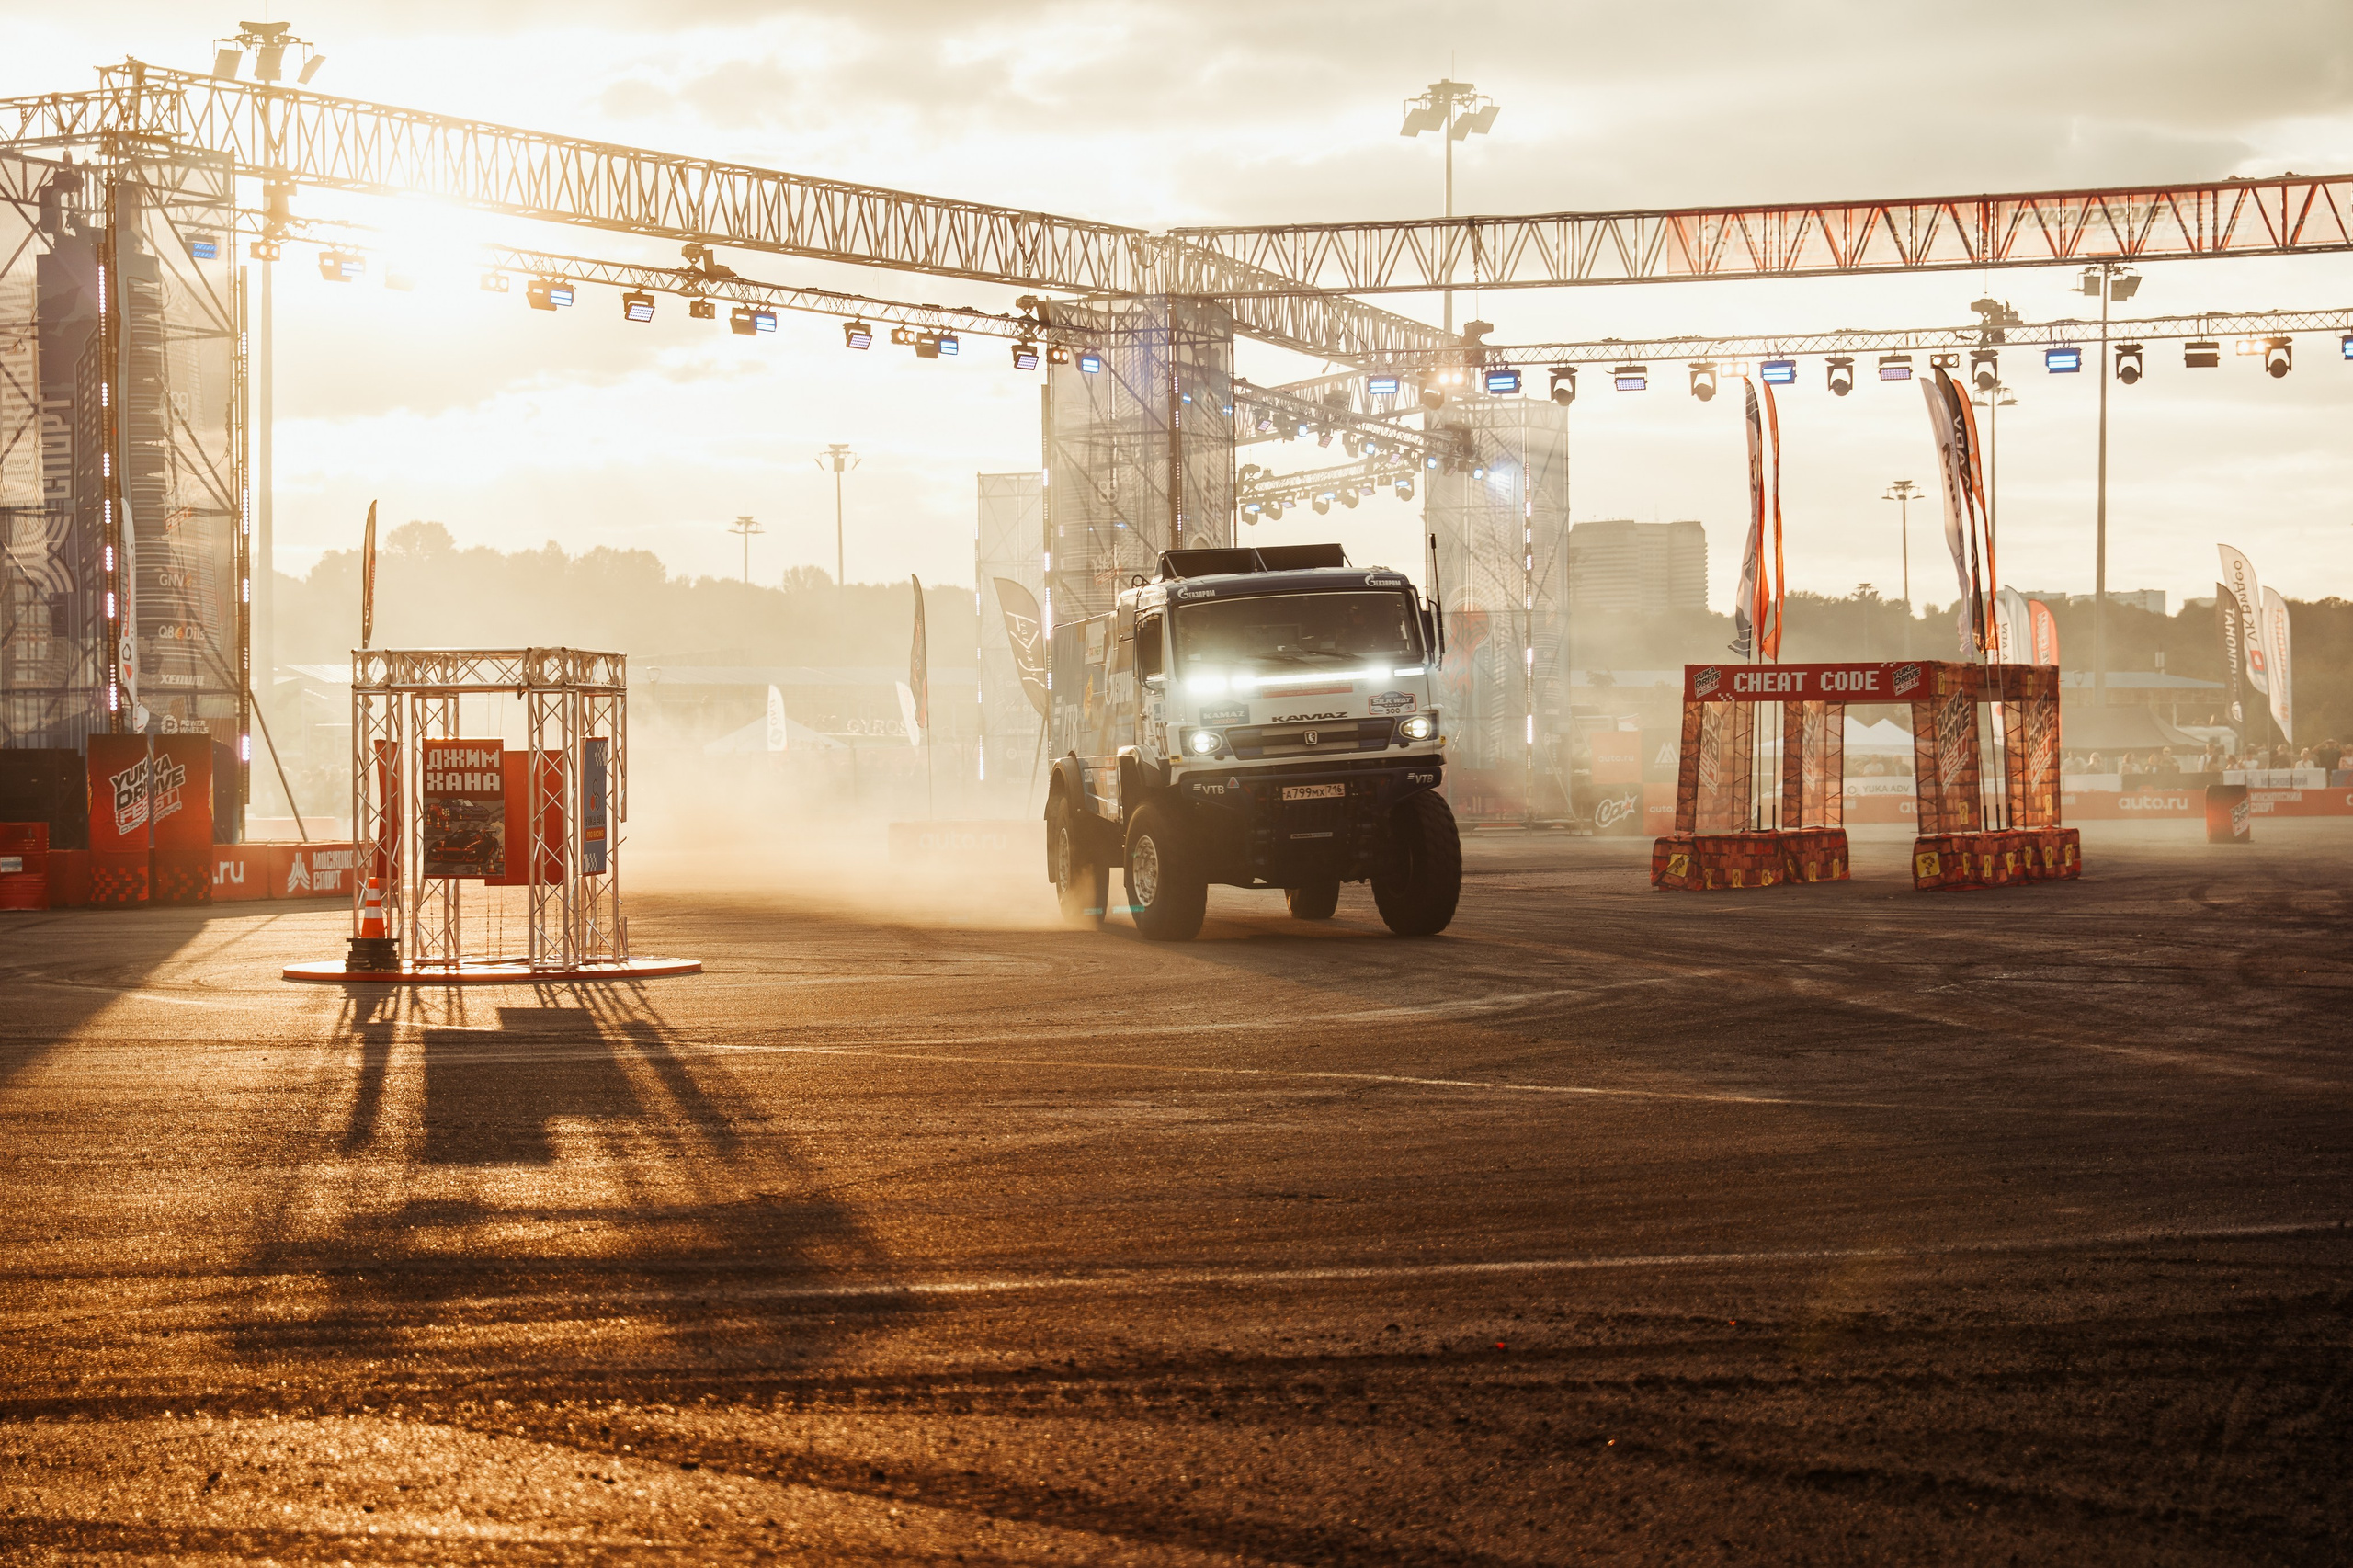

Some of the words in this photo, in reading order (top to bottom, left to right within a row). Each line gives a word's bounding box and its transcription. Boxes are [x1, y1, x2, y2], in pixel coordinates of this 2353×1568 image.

[40, 396, 74, 500] СПОРТ
[159, 573, 185, 587] GNV
[1375, 578, 1402, 586] ГАЗПРОМ
[1188, 588, 1216, 598] ГАЗПРОМ
[158, 625, 175, 640] Q8
[185, 626, 206, 641] Oils
[1694, 666, 1716, 681] YUKA
[1893, 663, 1915, 677] YUKA
[1894, 667, 1921, 687] DRIVE
[1695, 671, 1721, 688] DRIVE
[1733, 672, 1808, 692] CHEAT
[1820, 670, 1879, 691] CODE
[1202, 710, 1245, 720] KAMAZ
[1271, 711, 1348, 722] KAMAZ
[179, 726, 209, 734] WHEELS
[180, 719, 206, 727] POWER
[426, 749, 500, 771] ДЖИМ
[1597, 754, 1635, 764] auto.ru
[426, 772, 501, 791] ХАНА
[1415, 774, 1434, 784] VTB
[1202, 784, 1225, 795] VTB
[1326, 784, 1342, 793] 716
[1862, 784, 1889, 793] YUKA
[1890, 784, 1911, 793] ADV
[1649, 801, 1676, 813] auto.
[2118, 795, 2188, 811] auto.ru
[313, 848, 372, 870] МОСКОВС
[313, 869, 342, 891] СПОРТ
